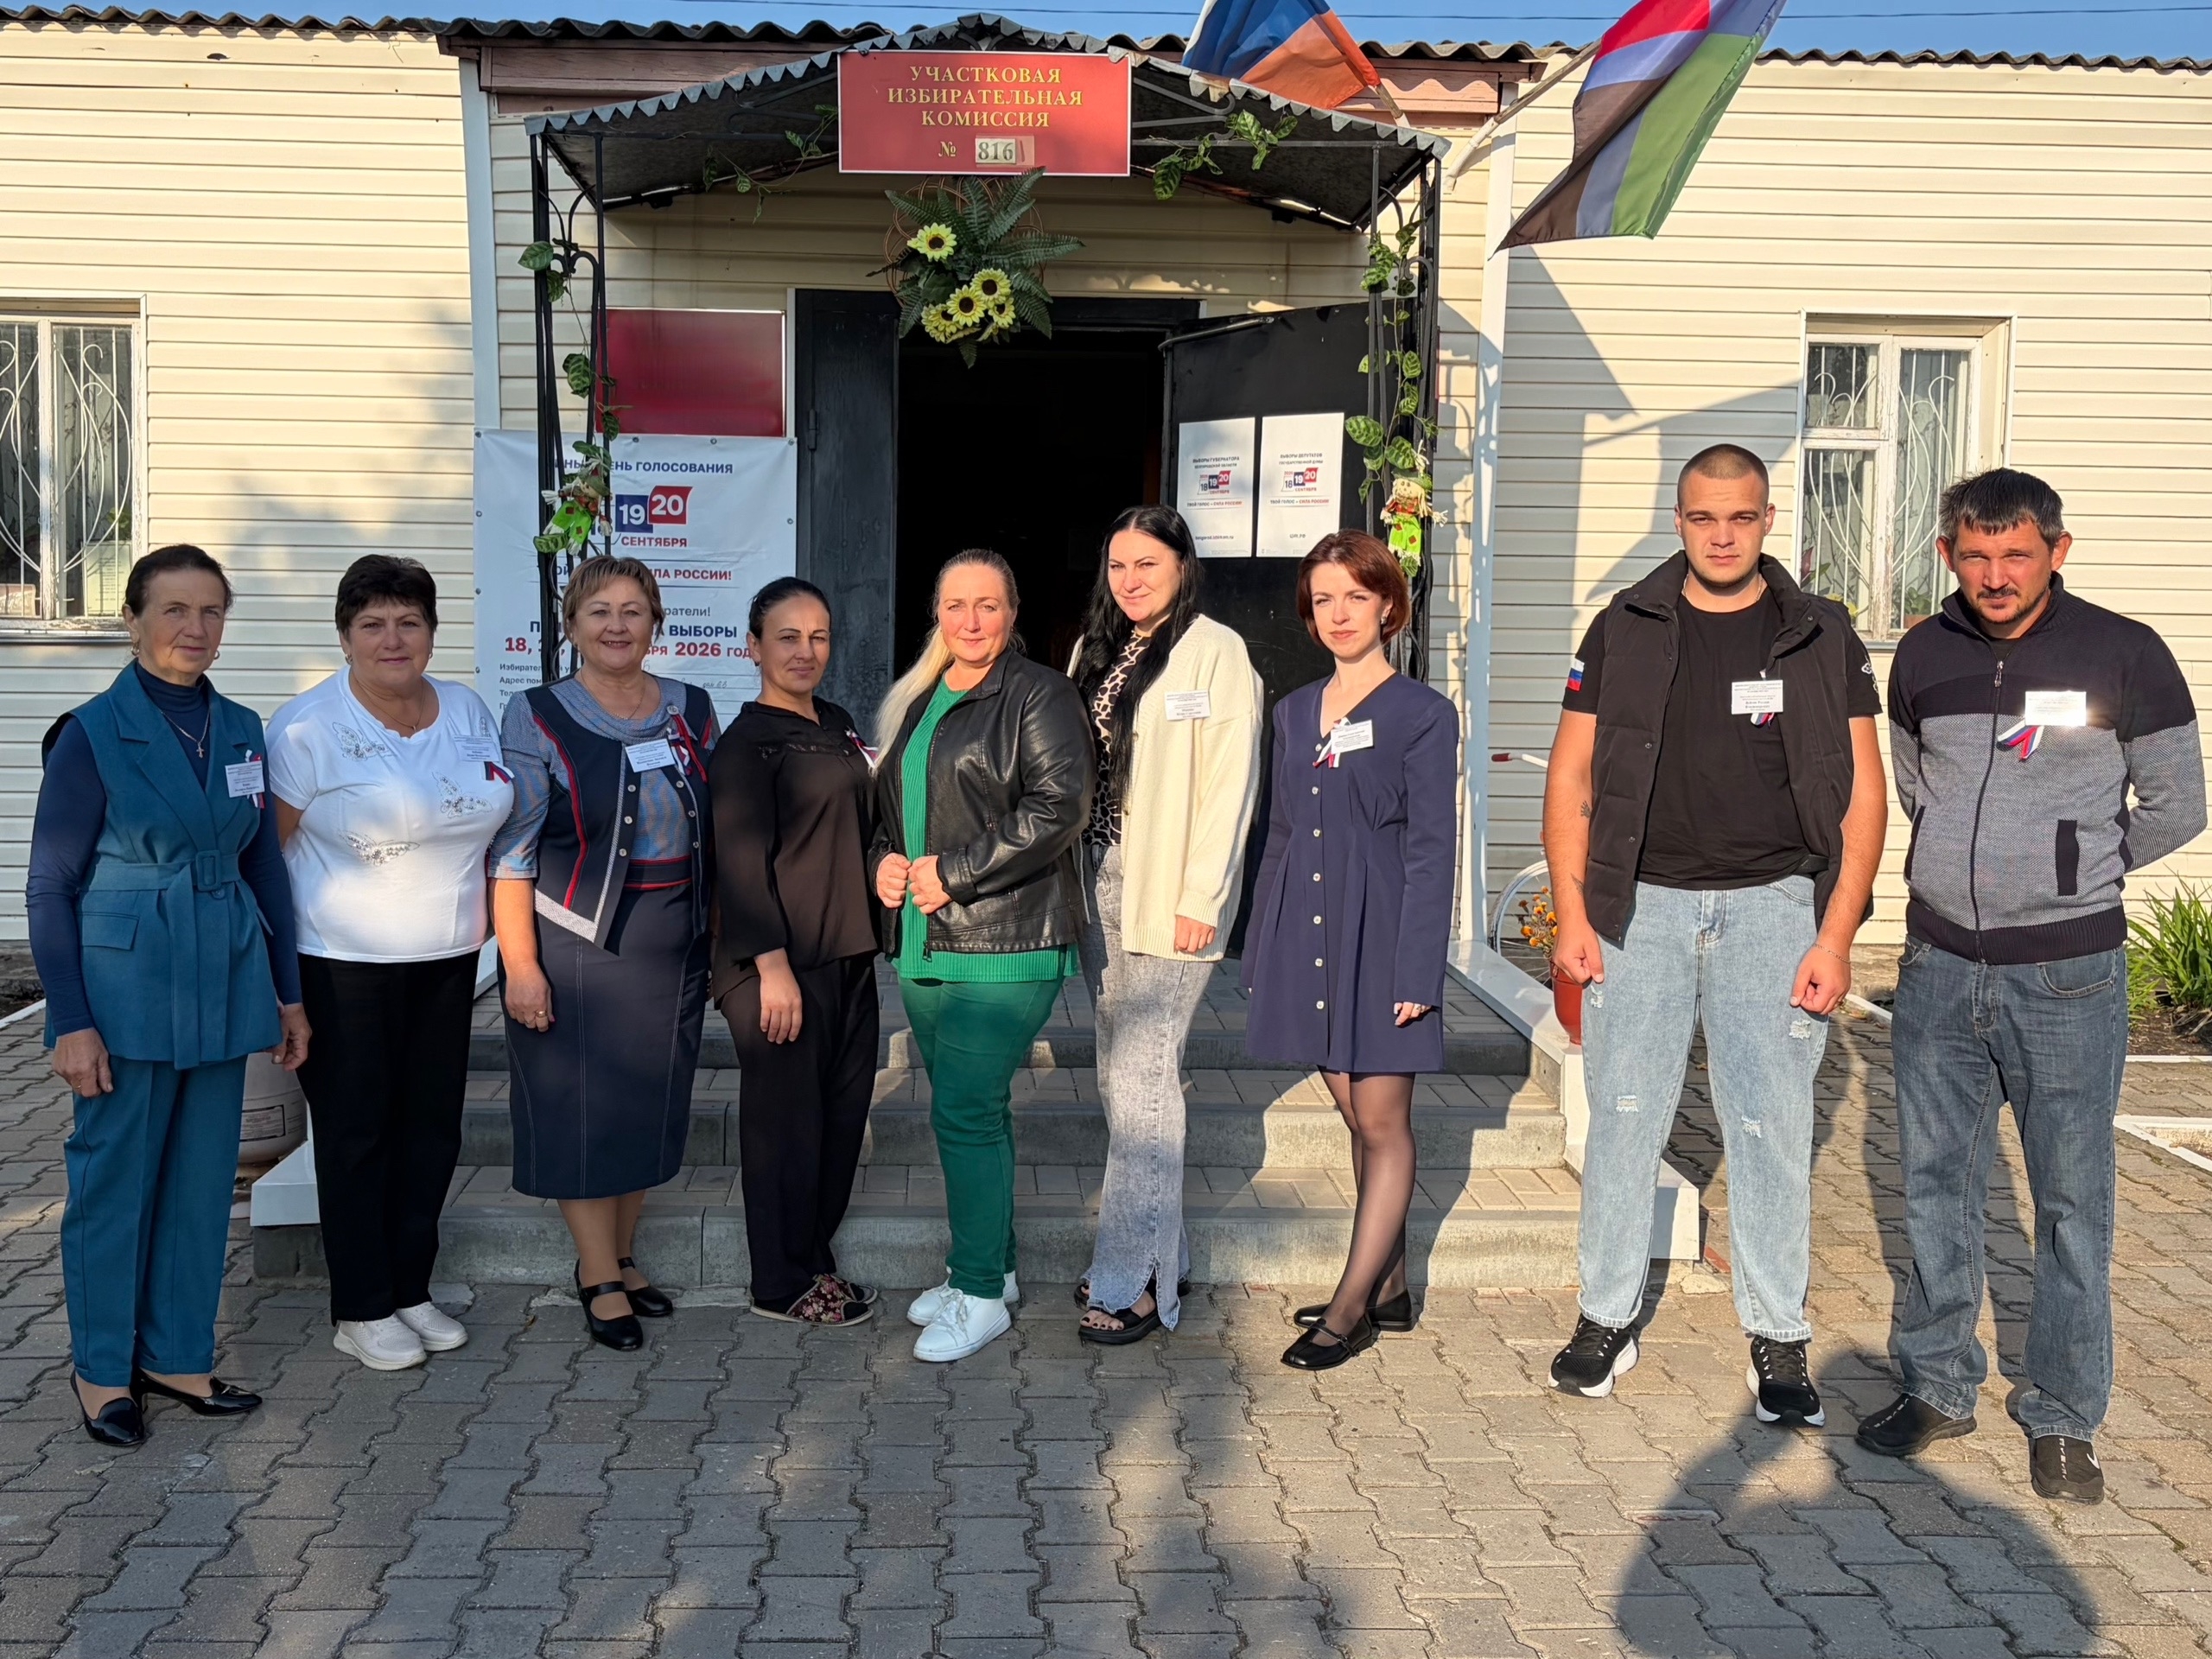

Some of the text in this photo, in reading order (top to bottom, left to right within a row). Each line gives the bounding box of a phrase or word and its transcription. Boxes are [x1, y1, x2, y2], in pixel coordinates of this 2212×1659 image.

[910, 67, 1061, 84] УЧАСТКОВАЯ
[887, 88, 1084, 105] ИЗБИРАТЕЛЬНАЯ
[921, 111, 1050, 127] КОМИССИЯ
[938, 141, 1014, 161] № 816
[636, 461, 734, 474] ГОЛОСОВАНИЯ
[1209, 478, 1217, 487] 19
[1218, 474, 1229, 482] 20
[1285, 471, 1316, 488] 18 19 20
[619, 494, 684, 525] 19 20
[621, 536, 687, 547] СЕНТЯБРЯ
[652, 569, 732, 581] ЛА РОССИИ!
[664, 607, 711, 617] ратели!
[669, 625, 737, 638] ВЫБОРЫ
[505, 637, 532, 655] 18,
[675, 642, 721, 657] 2026
[727, 647, 752, 658] ГОД
